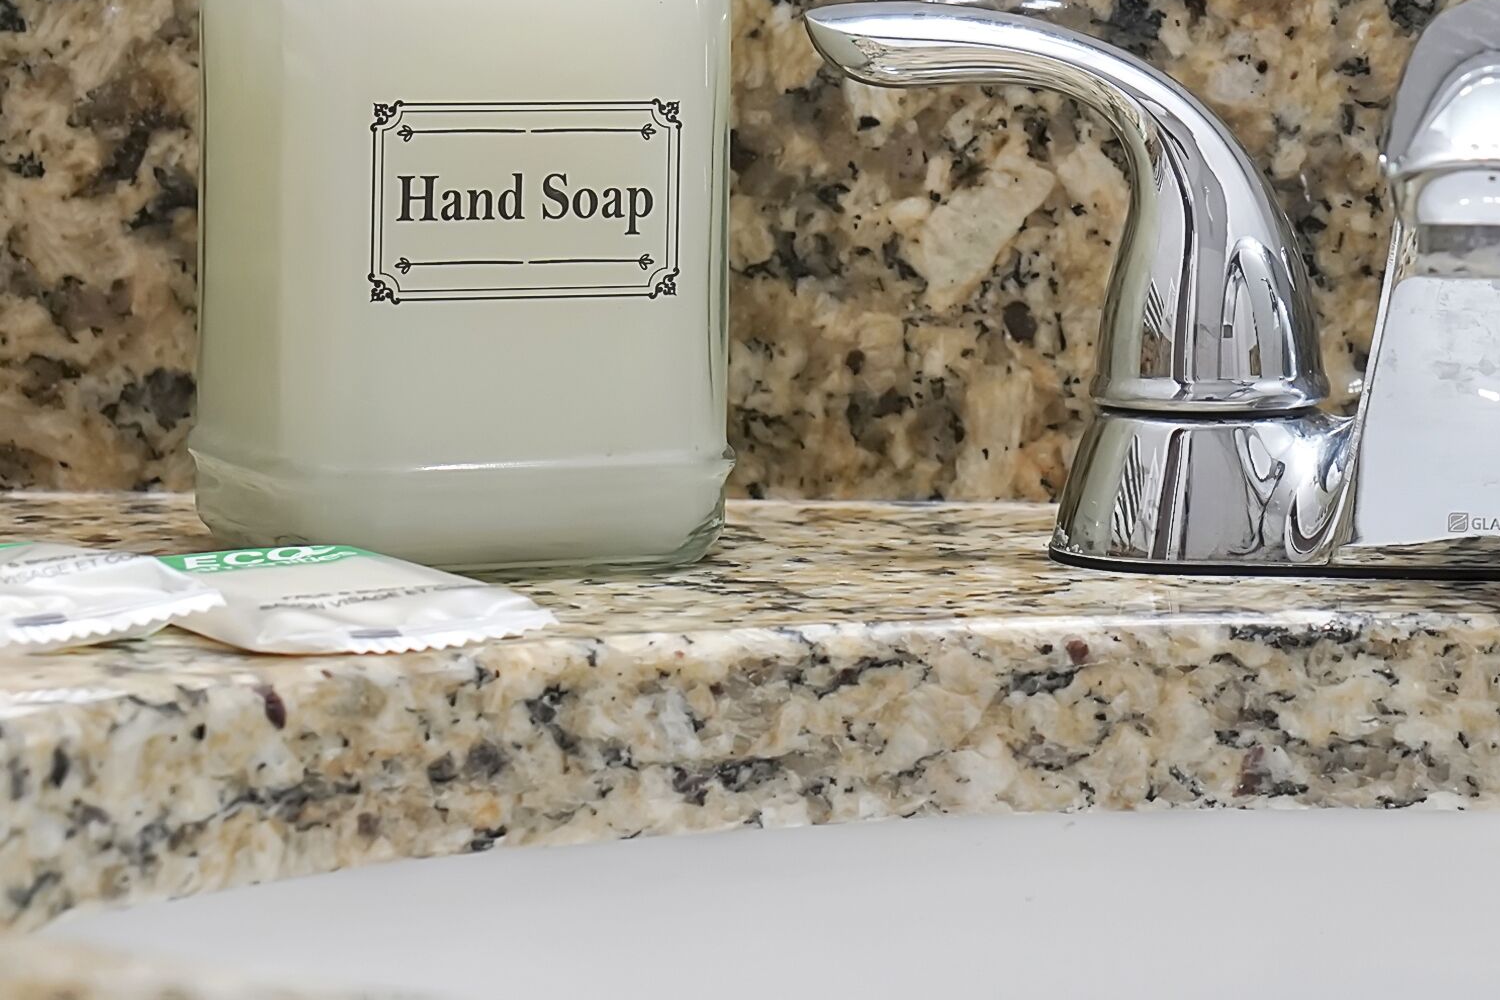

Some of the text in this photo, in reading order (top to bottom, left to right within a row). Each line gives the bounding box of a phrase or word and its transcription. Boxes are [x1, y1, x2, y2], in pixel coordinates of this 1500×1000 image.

[396, 173, 654, 235] Hand Soap
[183, 546, 314, 570] ECO
